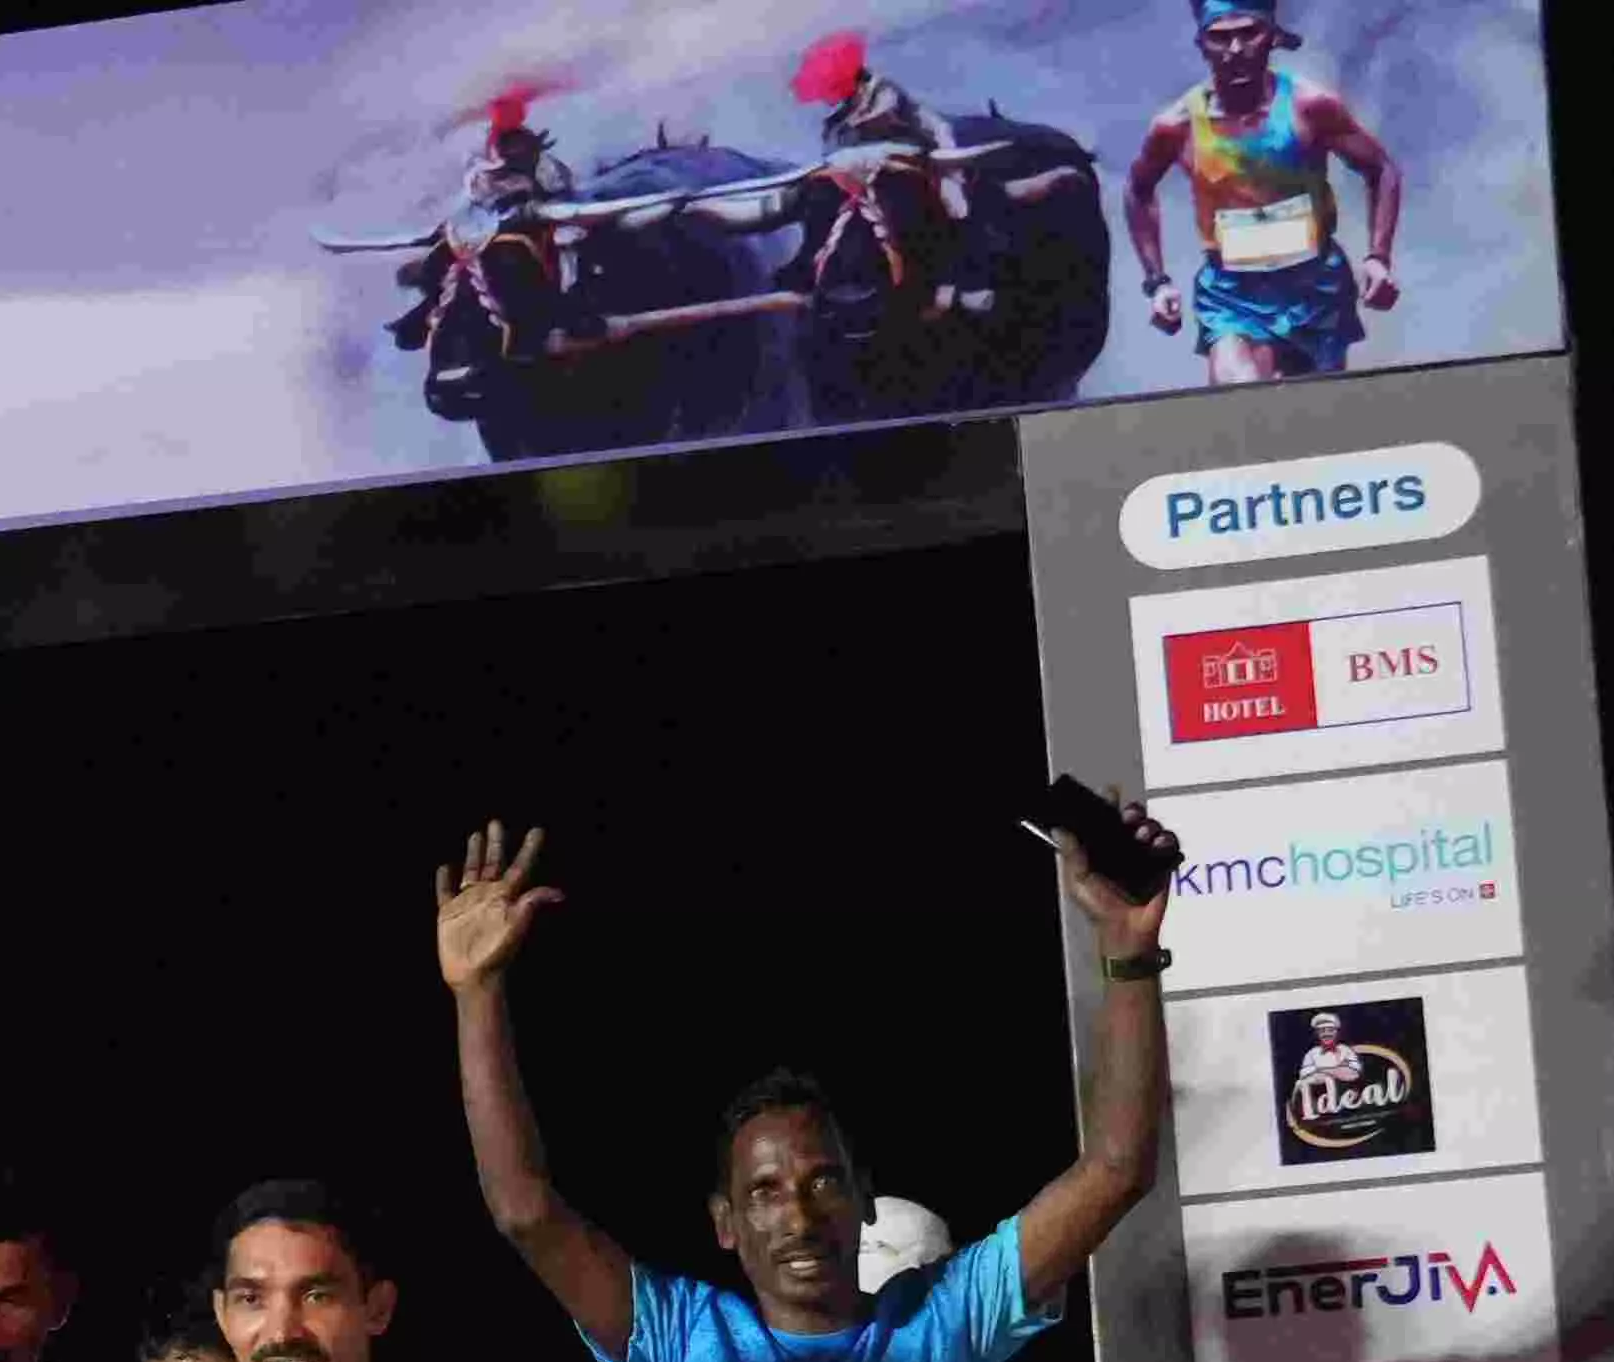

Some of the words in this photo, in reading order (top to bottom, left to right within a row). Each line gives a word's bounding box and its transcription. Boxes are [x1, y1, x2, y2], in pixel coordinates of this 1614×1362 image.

[1166, 474, 1426, 538] Partners
[1347, 645, 1439, 683] BMS
[1203, 696, 1285, 723] HOTEL
[1299, 1069, 1405, 1120] Ideal
